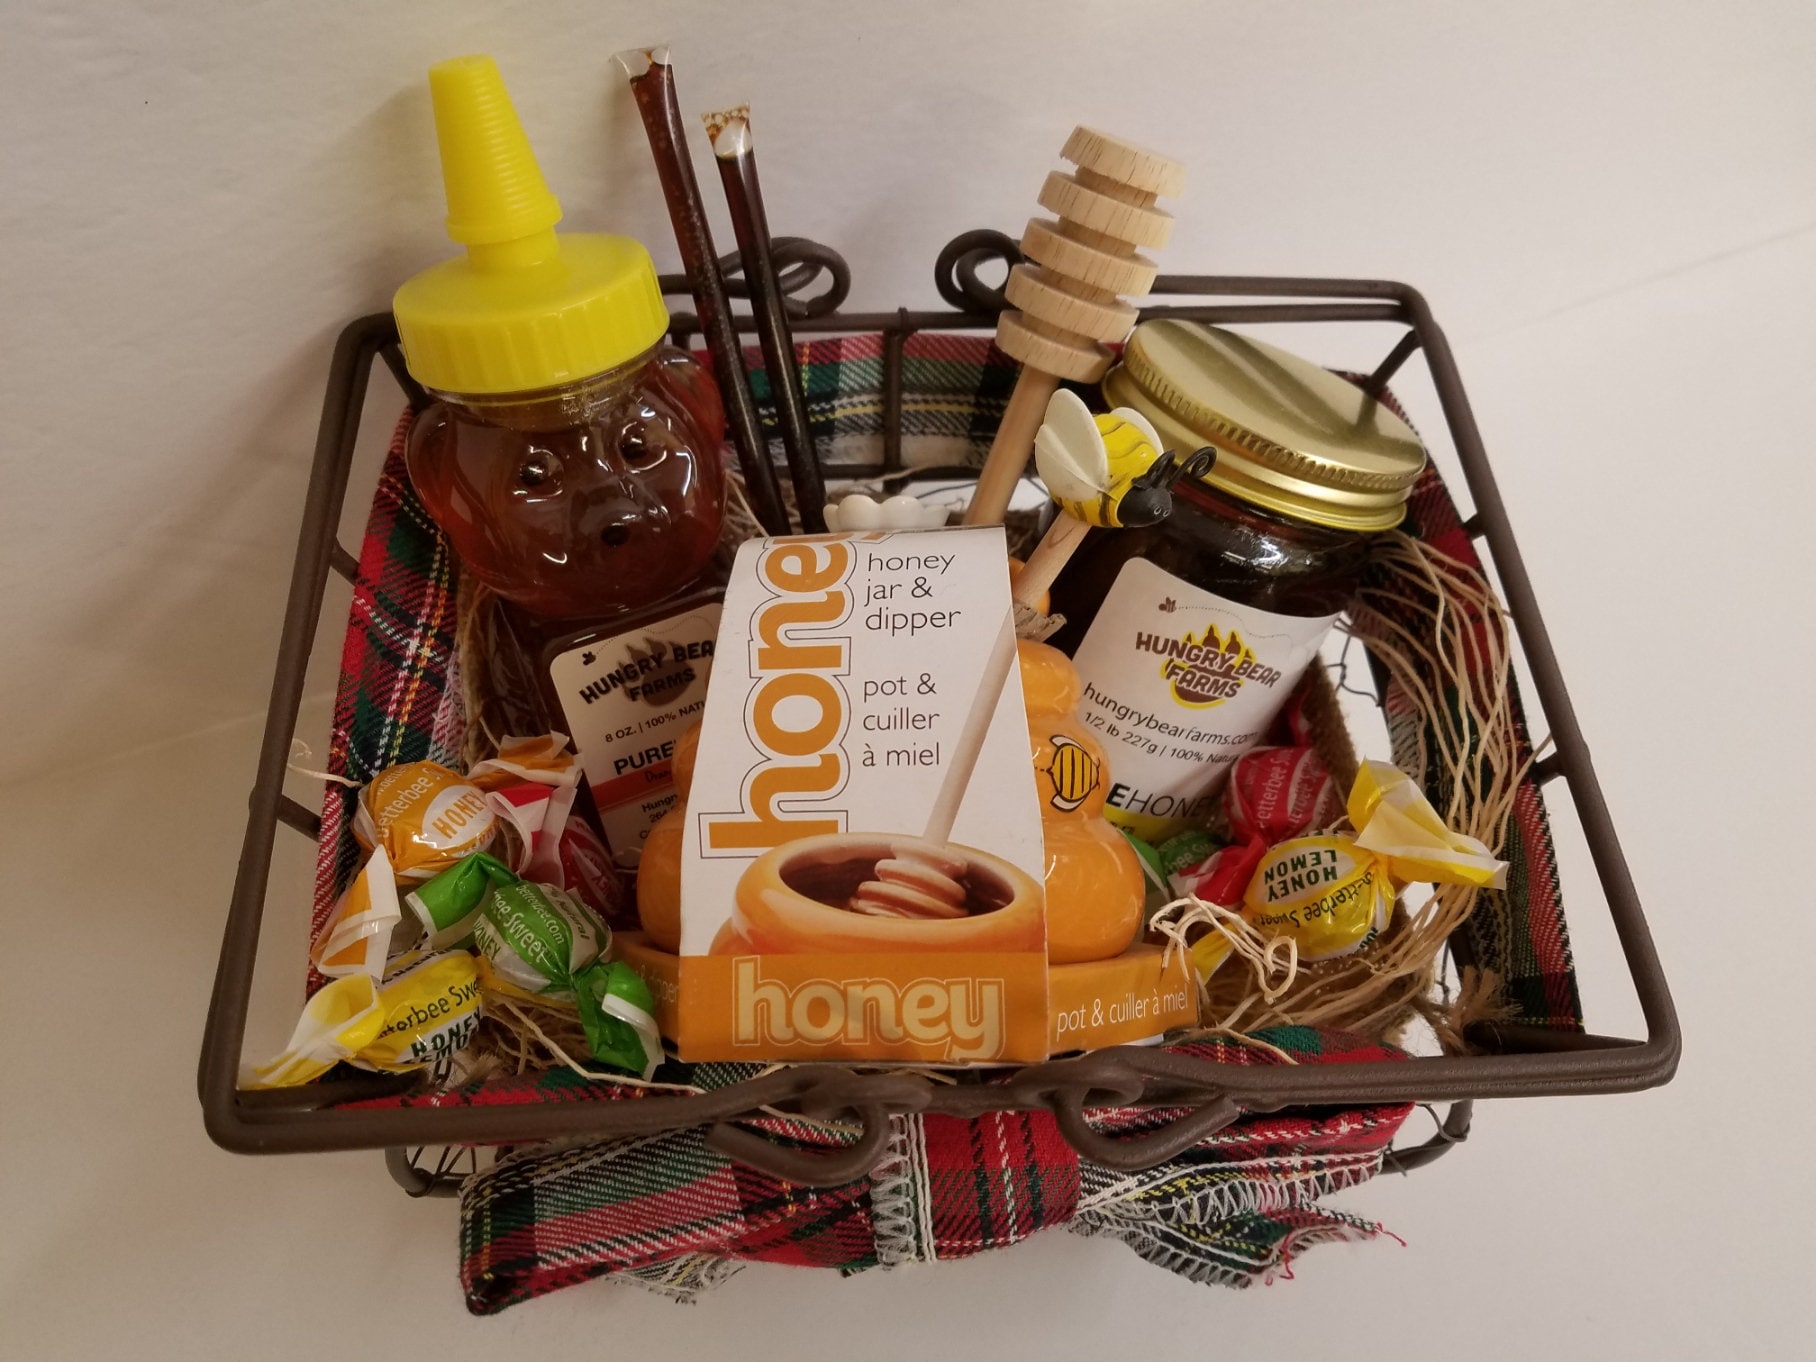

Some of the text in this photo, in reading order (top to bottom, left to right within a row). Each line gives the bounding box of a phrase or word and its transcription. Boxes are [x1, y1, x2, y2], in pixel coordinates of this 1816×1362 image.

[867, 553, 955, 575] honey
[864, 576, 933, 607] jar &
[865, 607, 961, 636] dipper
[578, 640, 714, 704] HUNGRY BEA
[1135, 631, 1282, 689] HUNGRY BEAR
[629, 667, 696, 702] FARMS
[863, 672, 937, 703] pot &
[1165, 663, 1242, 699] FARMS
[604, 733, 614, 744] 8
[645, 711, 677, 729] 100%
[862, 707, 940, 731] cuiller
[862, 742, 940, 767] à miel
[1083, 711, 1104, 730] 1/2
[1106, 723, 1120, 738] lb
[1121, 730, 1159, 756] 227g
[1170, 746, 1204, 763] 100%
[613, 740, 676, 775] PURE
[431, 789, 488, 840] HONEY
[641, 793, 678, 813] Hungr
[1264, 849, 1338, 886] LEMON
[1266, 865, 1338, 903] HONEY
[503, 911, 546, 964] Sweet
[732, 956, 1004, 1061] honey
[1056, 986, 1190, 1041] pot & cuiller à miel
